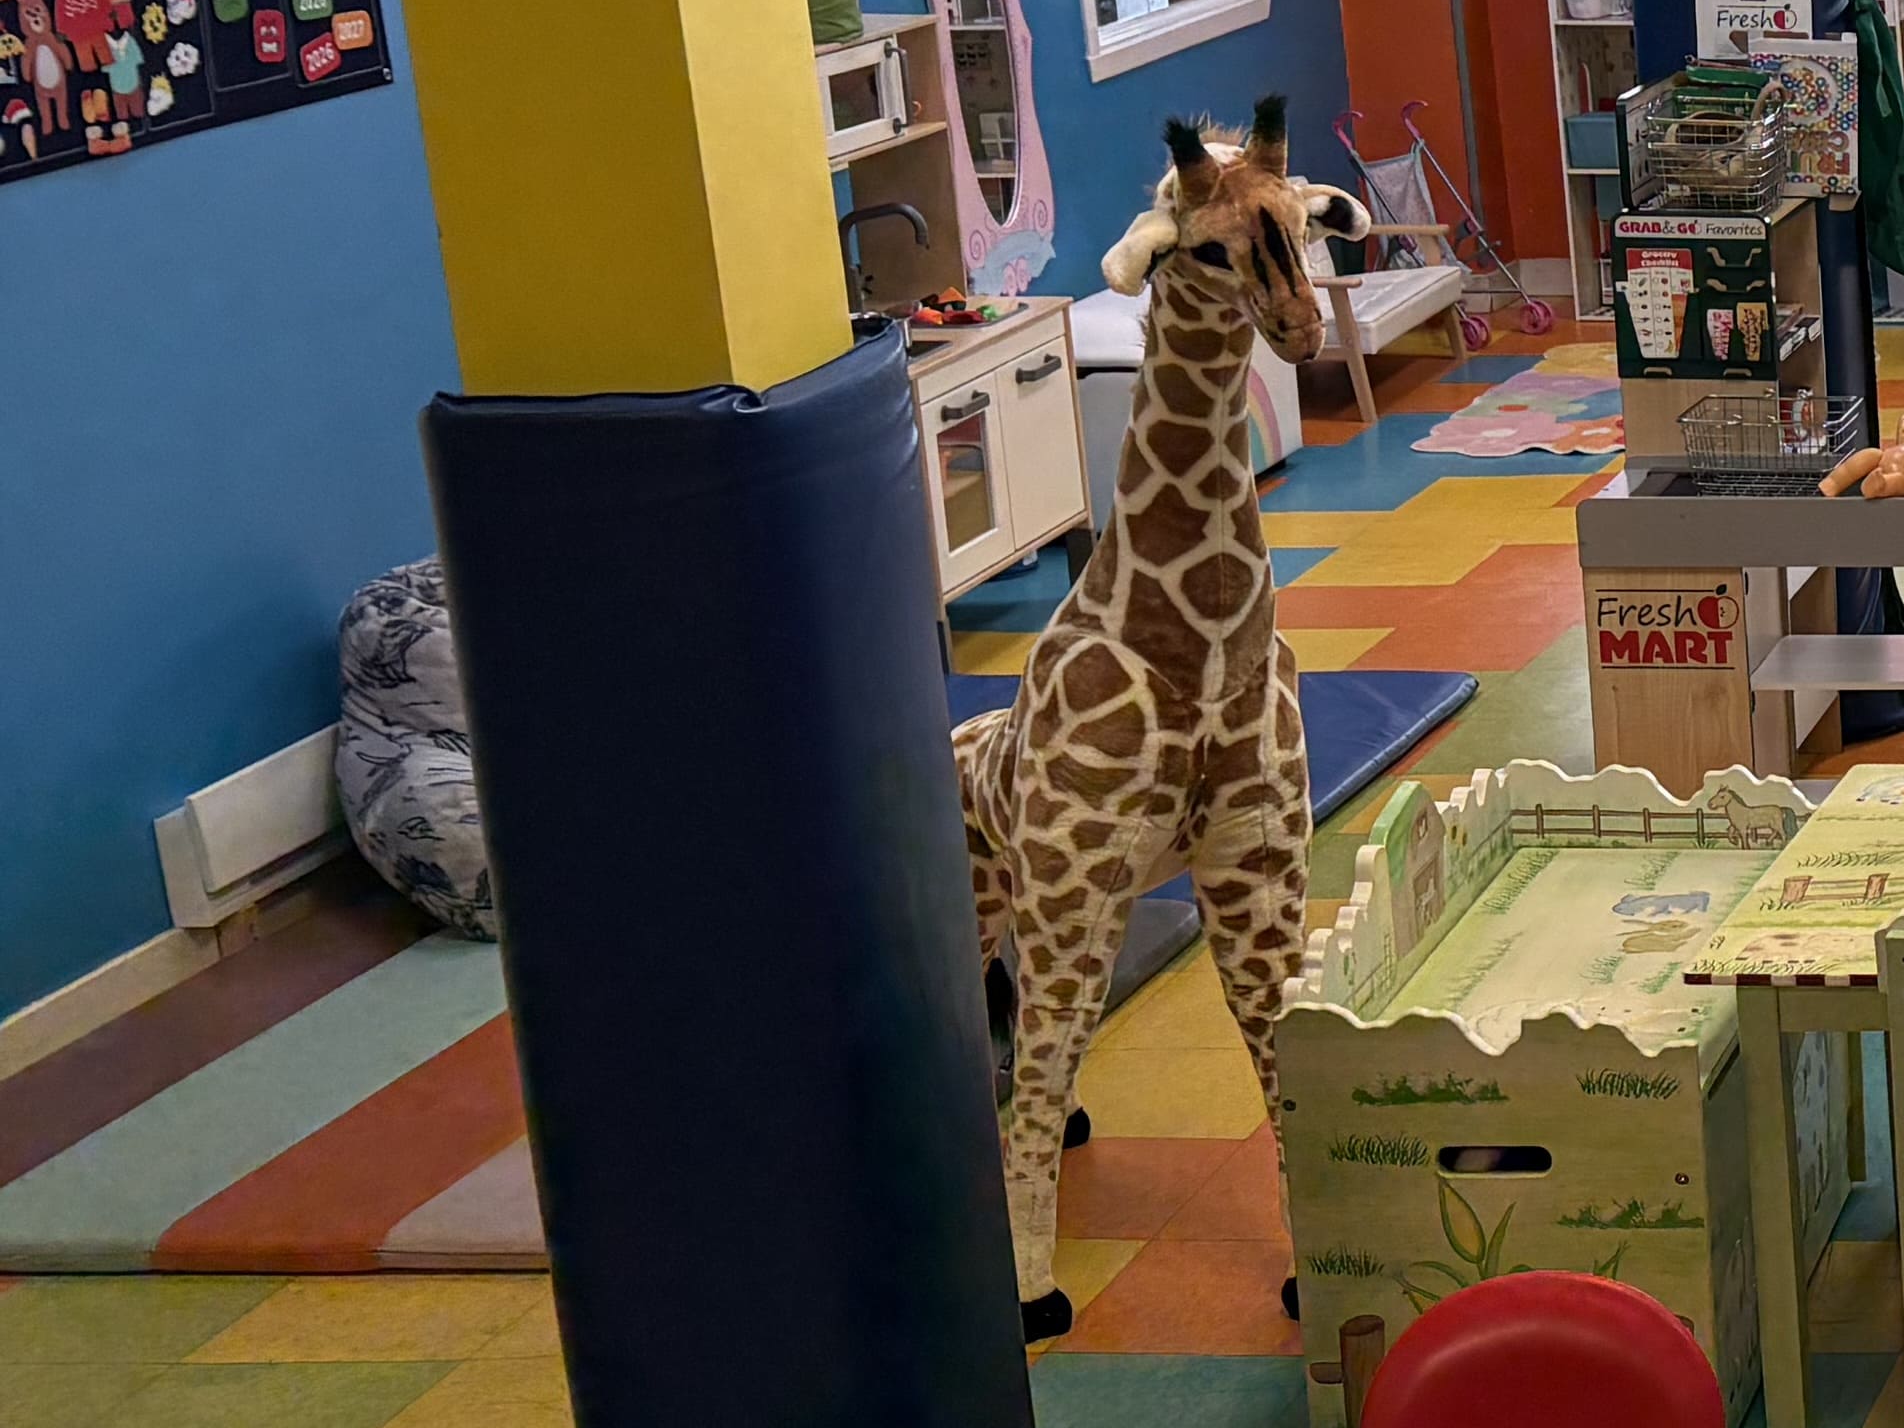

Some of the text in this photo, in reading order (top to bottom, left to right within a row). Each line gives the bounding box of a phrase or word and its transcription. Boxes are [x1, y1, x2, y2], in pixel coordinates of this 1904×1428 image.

[1716, 9, 1774, 29] Fresh
[1619, 220, 1662, 234] GRAB
[1705, 222, 1763, 236] Favorites
[1597, 595, 1698, 627] Fresh
[1600, 630, 1733, 664] MART
